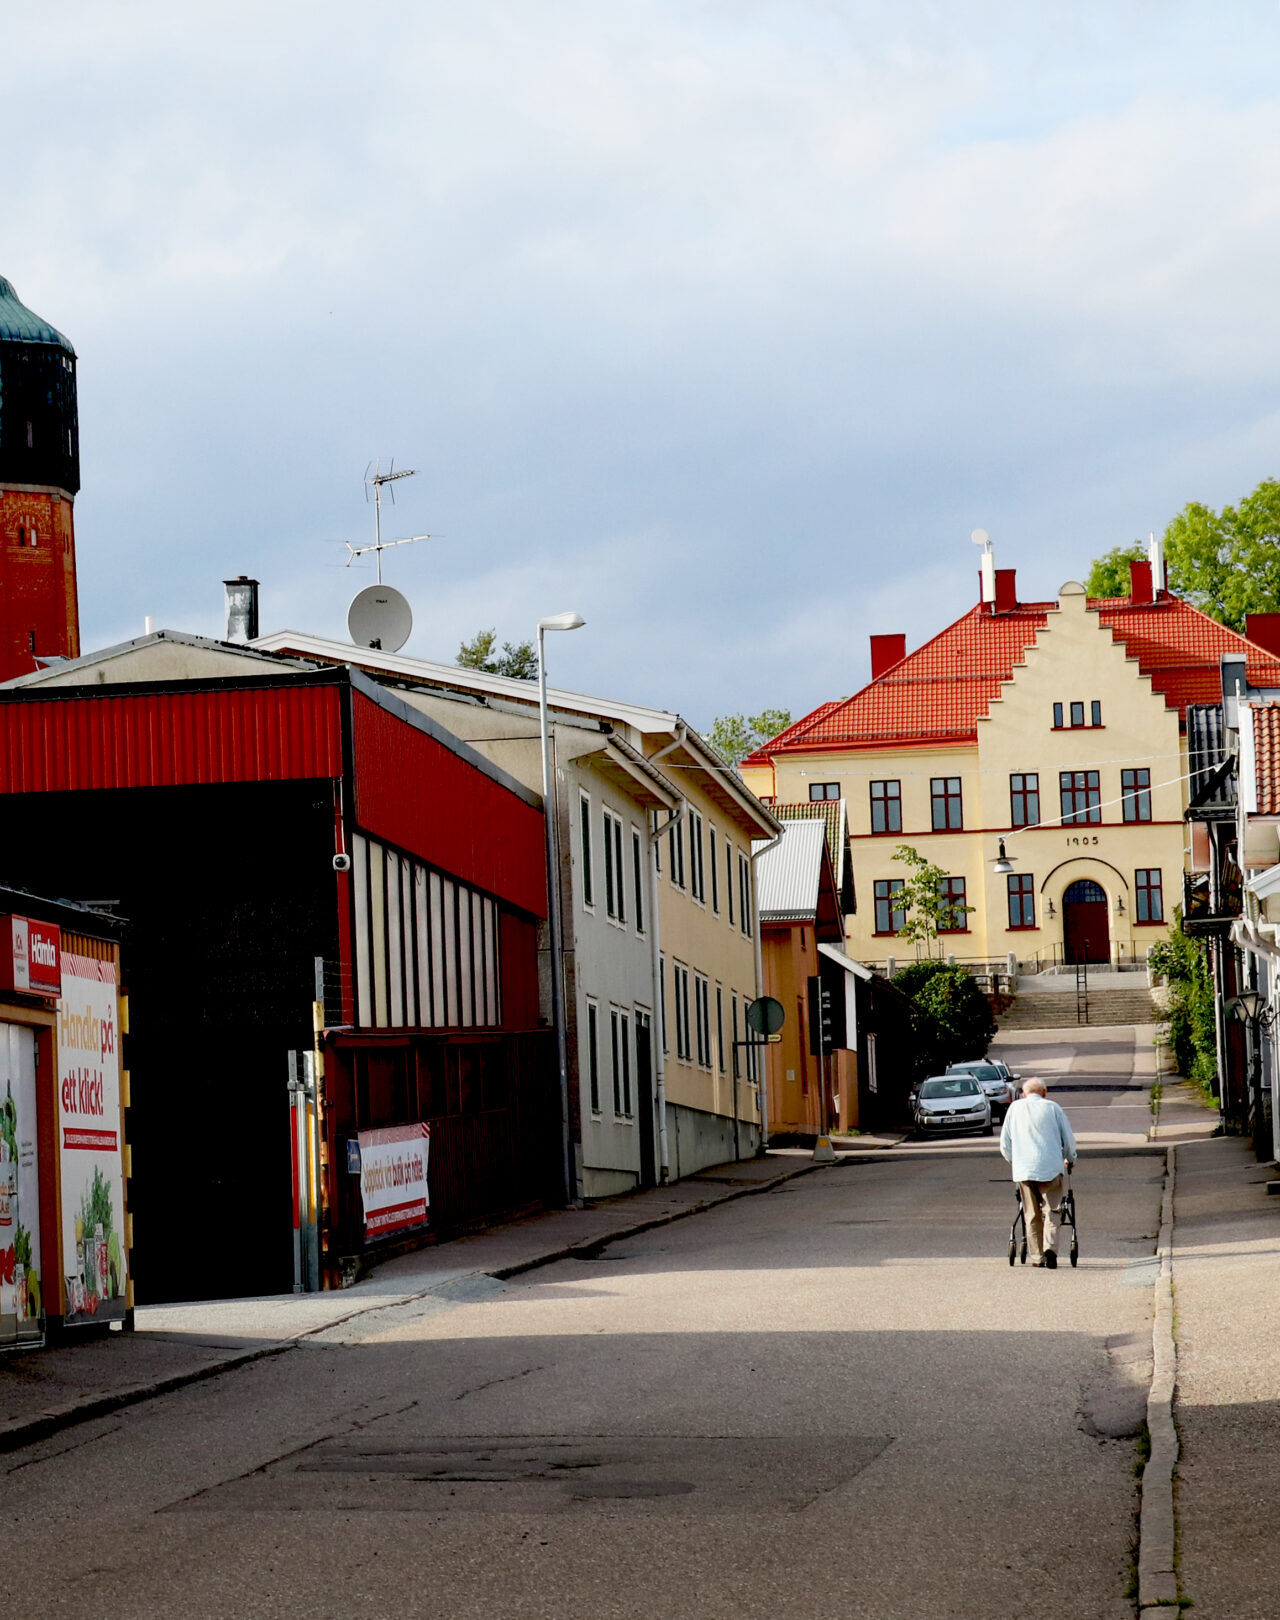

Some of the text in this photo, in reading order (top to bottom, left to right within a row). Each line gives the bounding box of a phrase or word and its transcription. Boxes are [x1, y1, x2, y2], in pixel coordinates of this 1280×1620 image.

[1066, 836, 1099, 846] 1905
[31, 933, 56, 967] Hämta
[60, 1001, 115, 1065] Handla på
[62, 1067, 104, 1116] ett klick!
